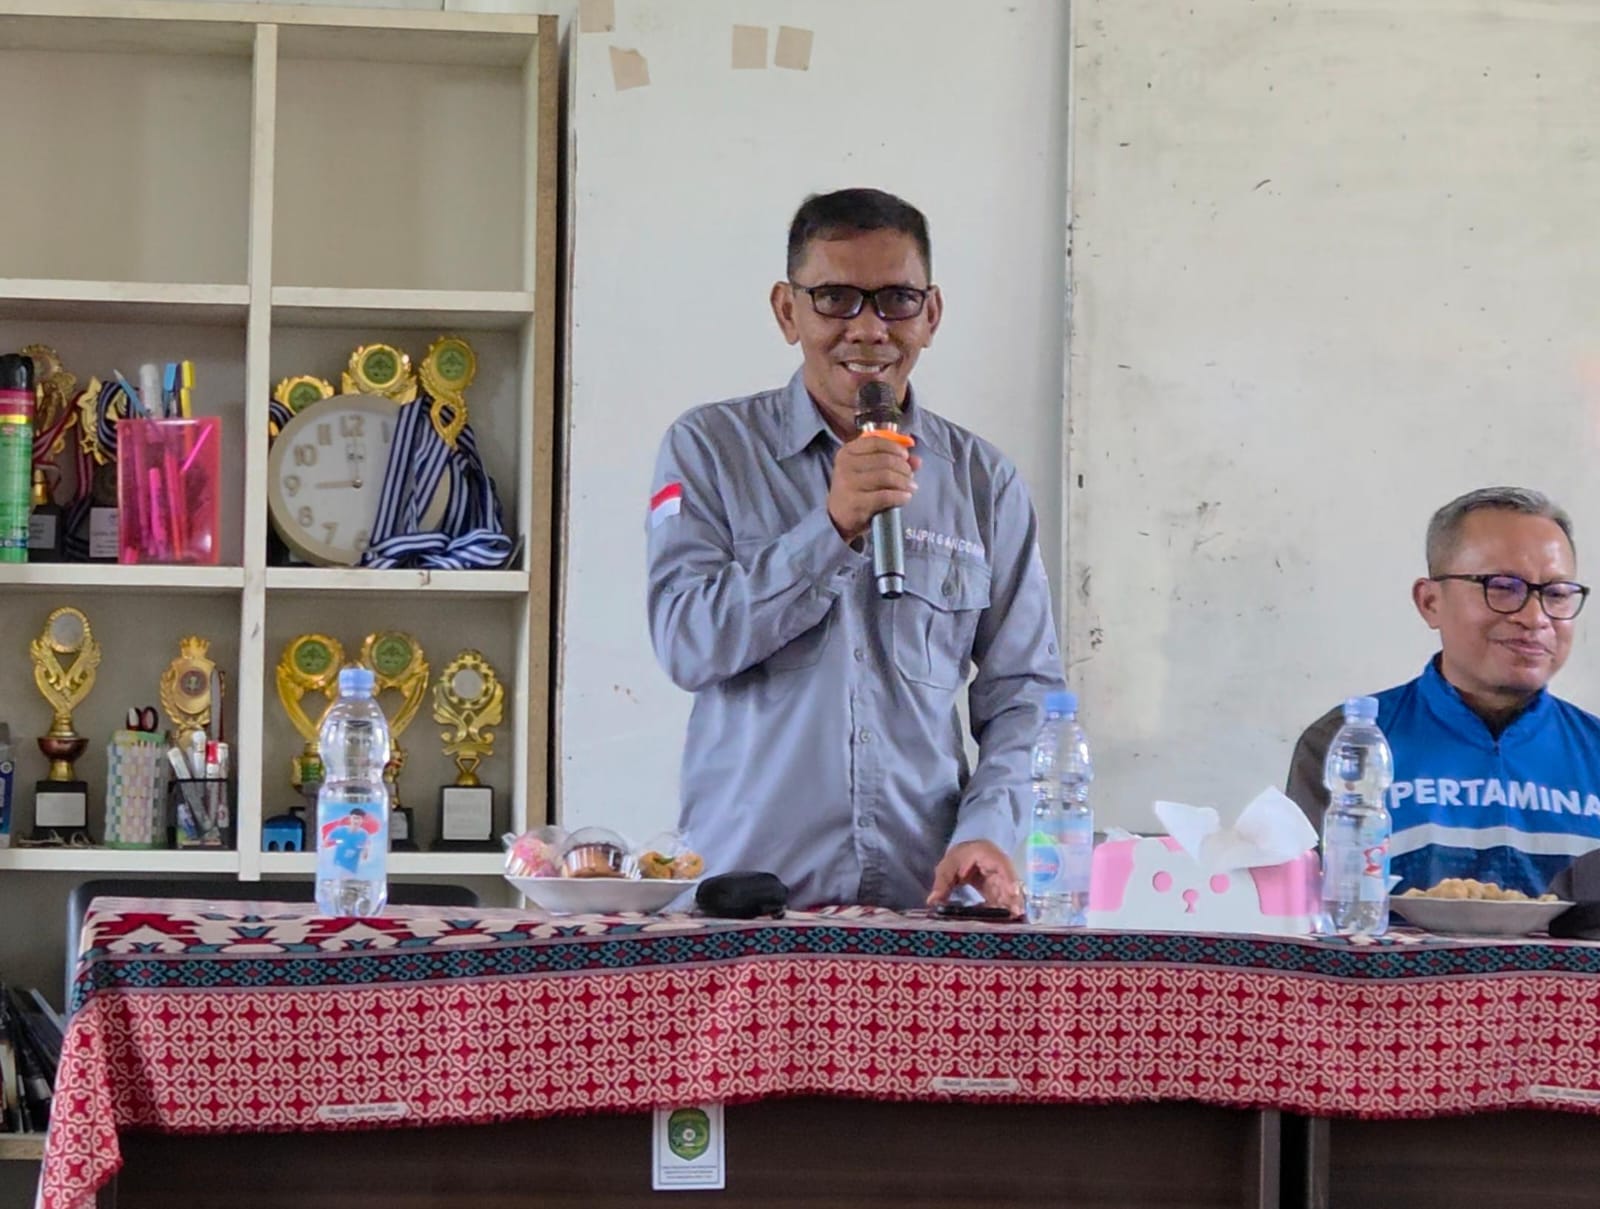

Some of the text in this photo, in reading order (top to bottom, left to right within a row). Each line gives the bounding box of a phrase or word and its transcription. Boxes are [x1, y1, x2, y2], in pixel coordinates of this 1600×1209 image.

[294, 443, 318, 466] 10
[284, 474, 300, 497] 9
[321, 521, 339, 545] 7
[1389, 778, 1600, 817] PERTAMINA
